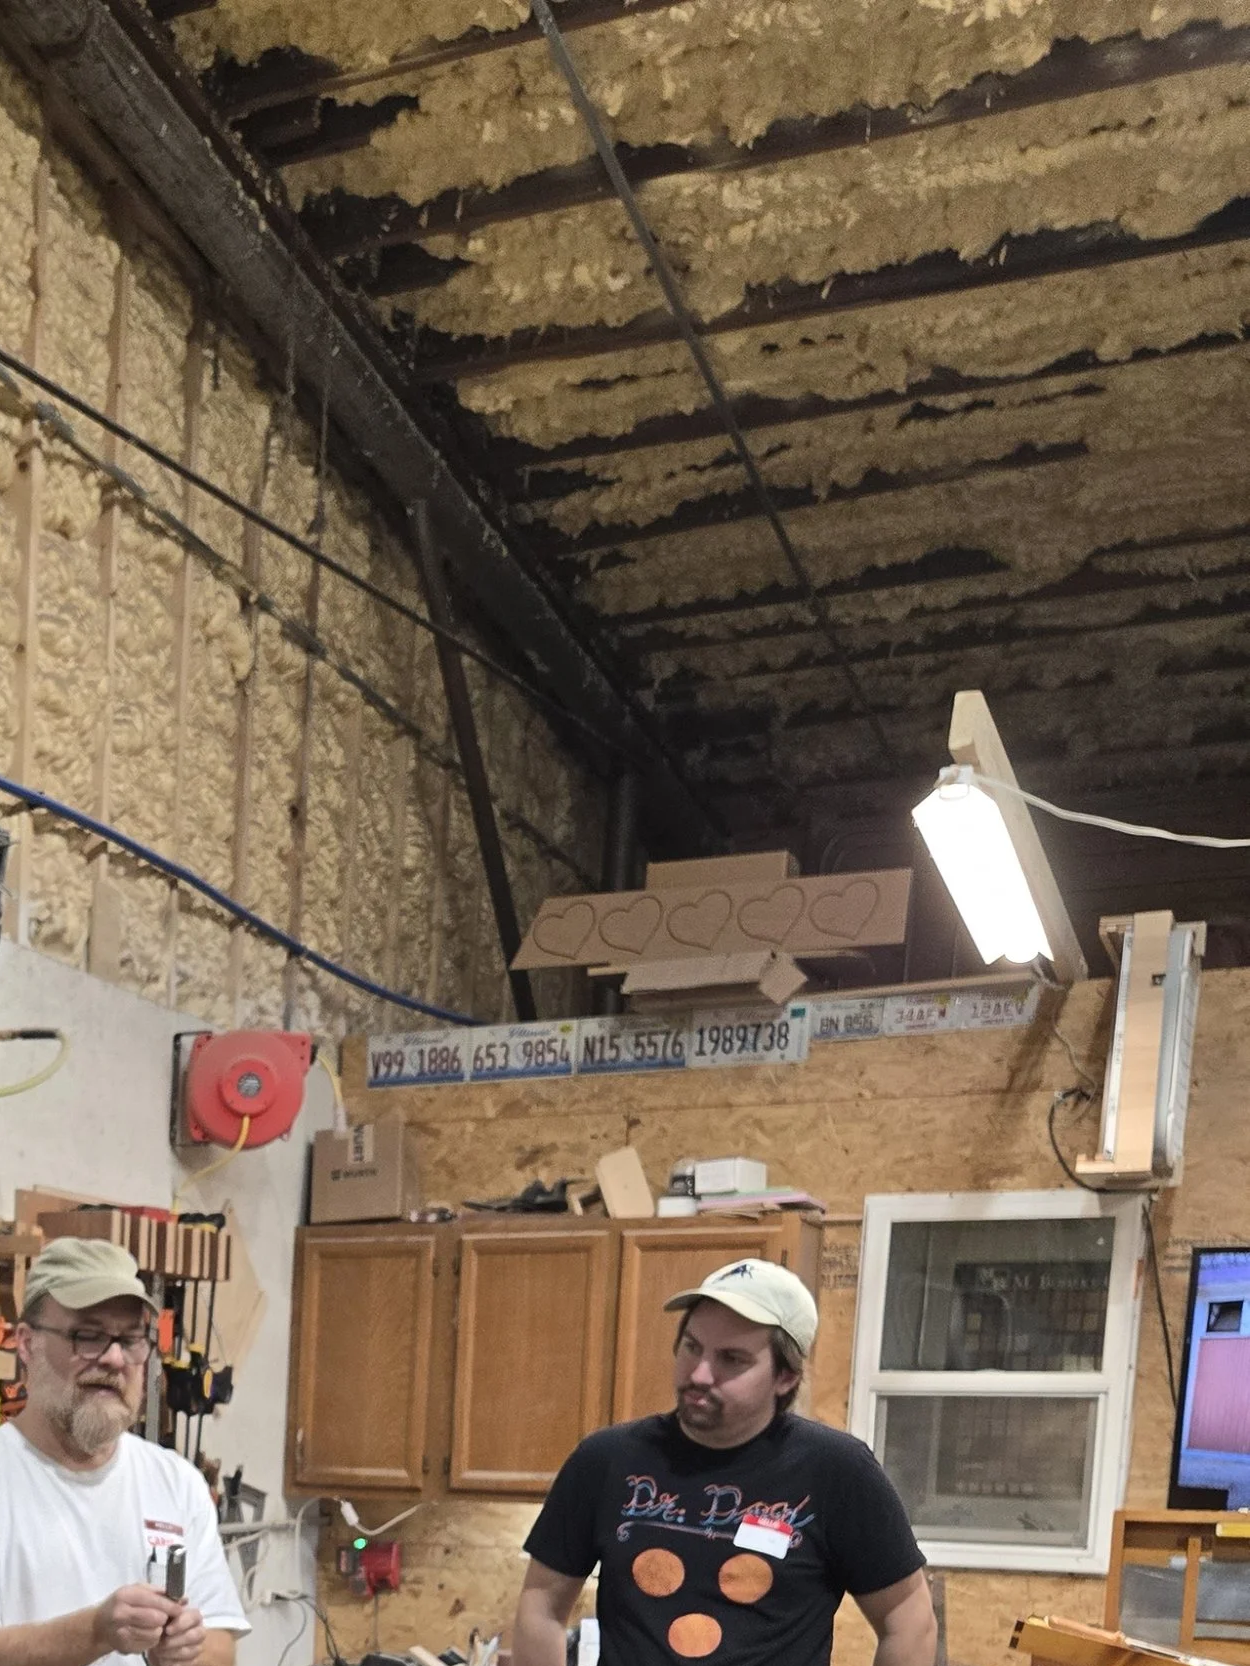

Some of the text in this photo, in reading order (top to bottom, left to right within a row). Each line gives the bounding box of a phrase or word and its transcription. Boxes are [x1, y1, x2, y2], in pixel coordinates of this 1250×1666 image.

[472, 1037, 571, 1073] 653 9854
[583, 1028, 685, 1065] N15 5576
[694, 1020, 790, 1057] 1989738
[371, 1043, 463, 1080] V99 1886
[621, 1474, 686, 1524] Dr.
